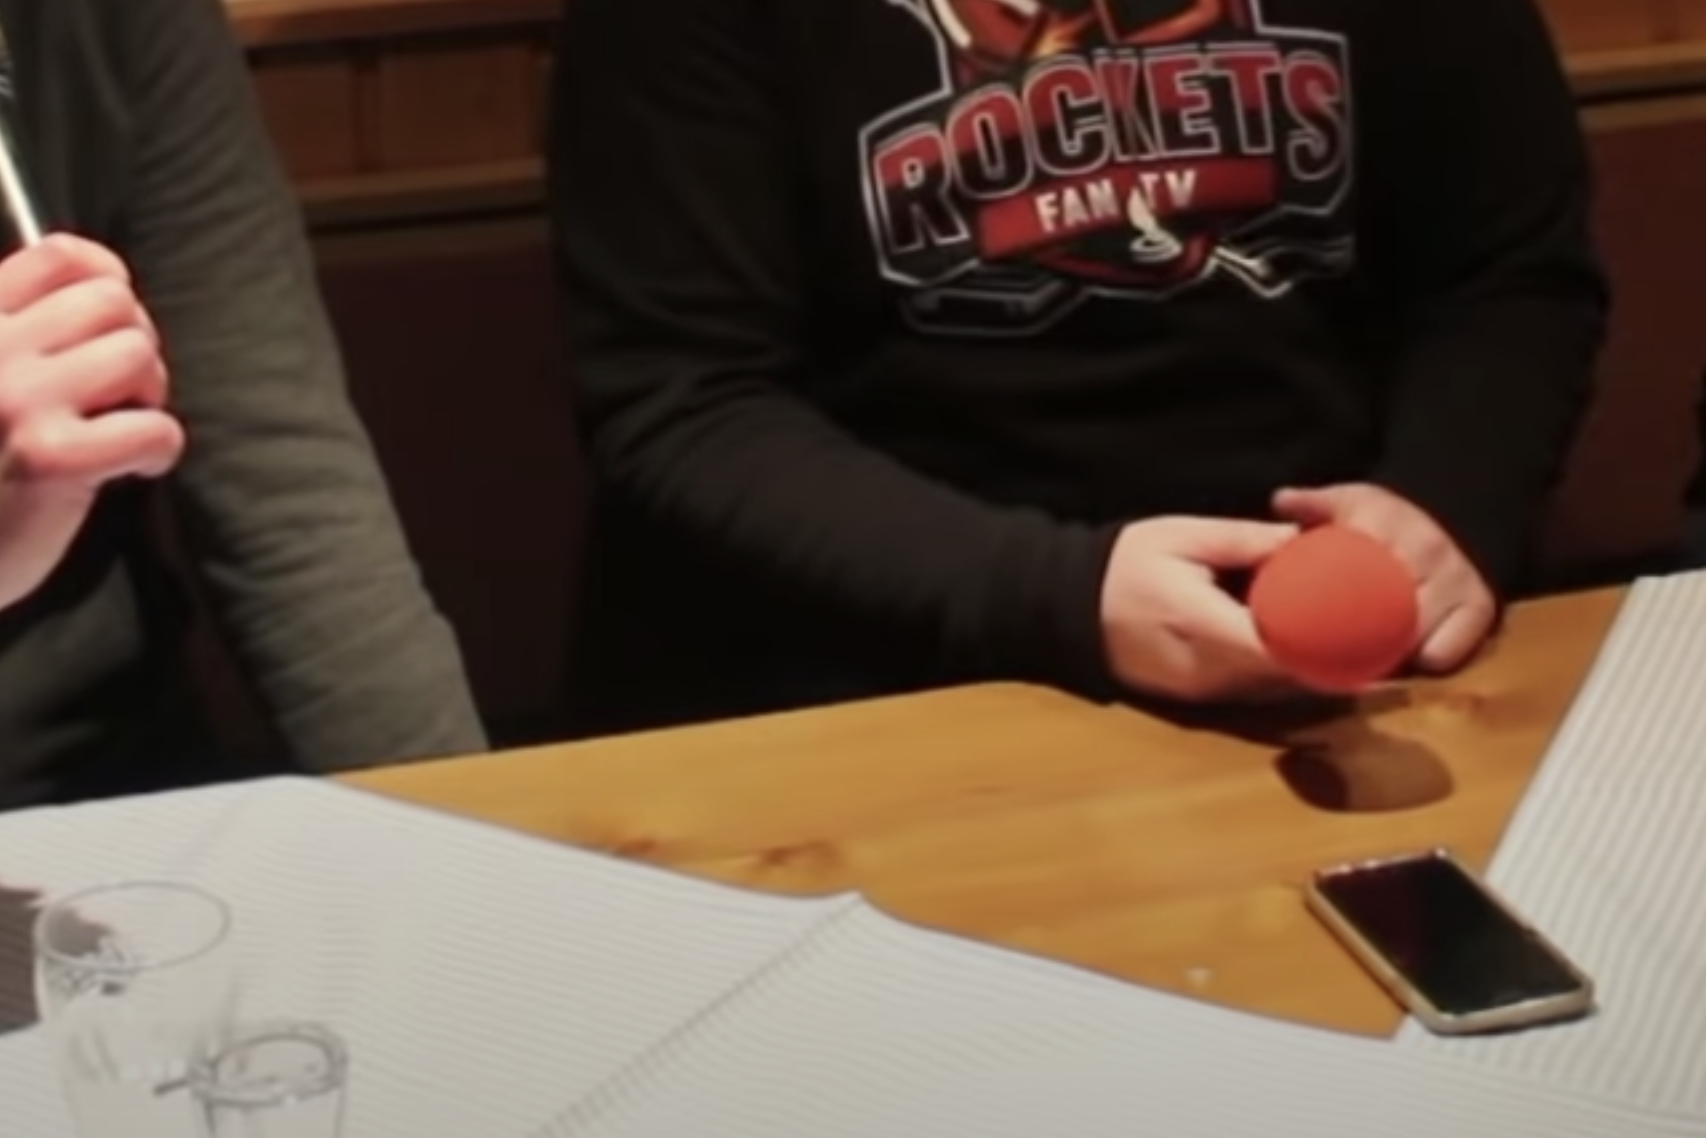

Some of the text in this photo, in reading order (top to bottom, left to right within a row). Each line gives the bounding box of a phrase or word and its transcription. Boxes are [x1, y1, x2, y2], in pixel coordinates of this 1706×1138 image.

[873, 43, 1347, 254] ROCKETS
[1034, 169, 1199, 232] FAN TV
